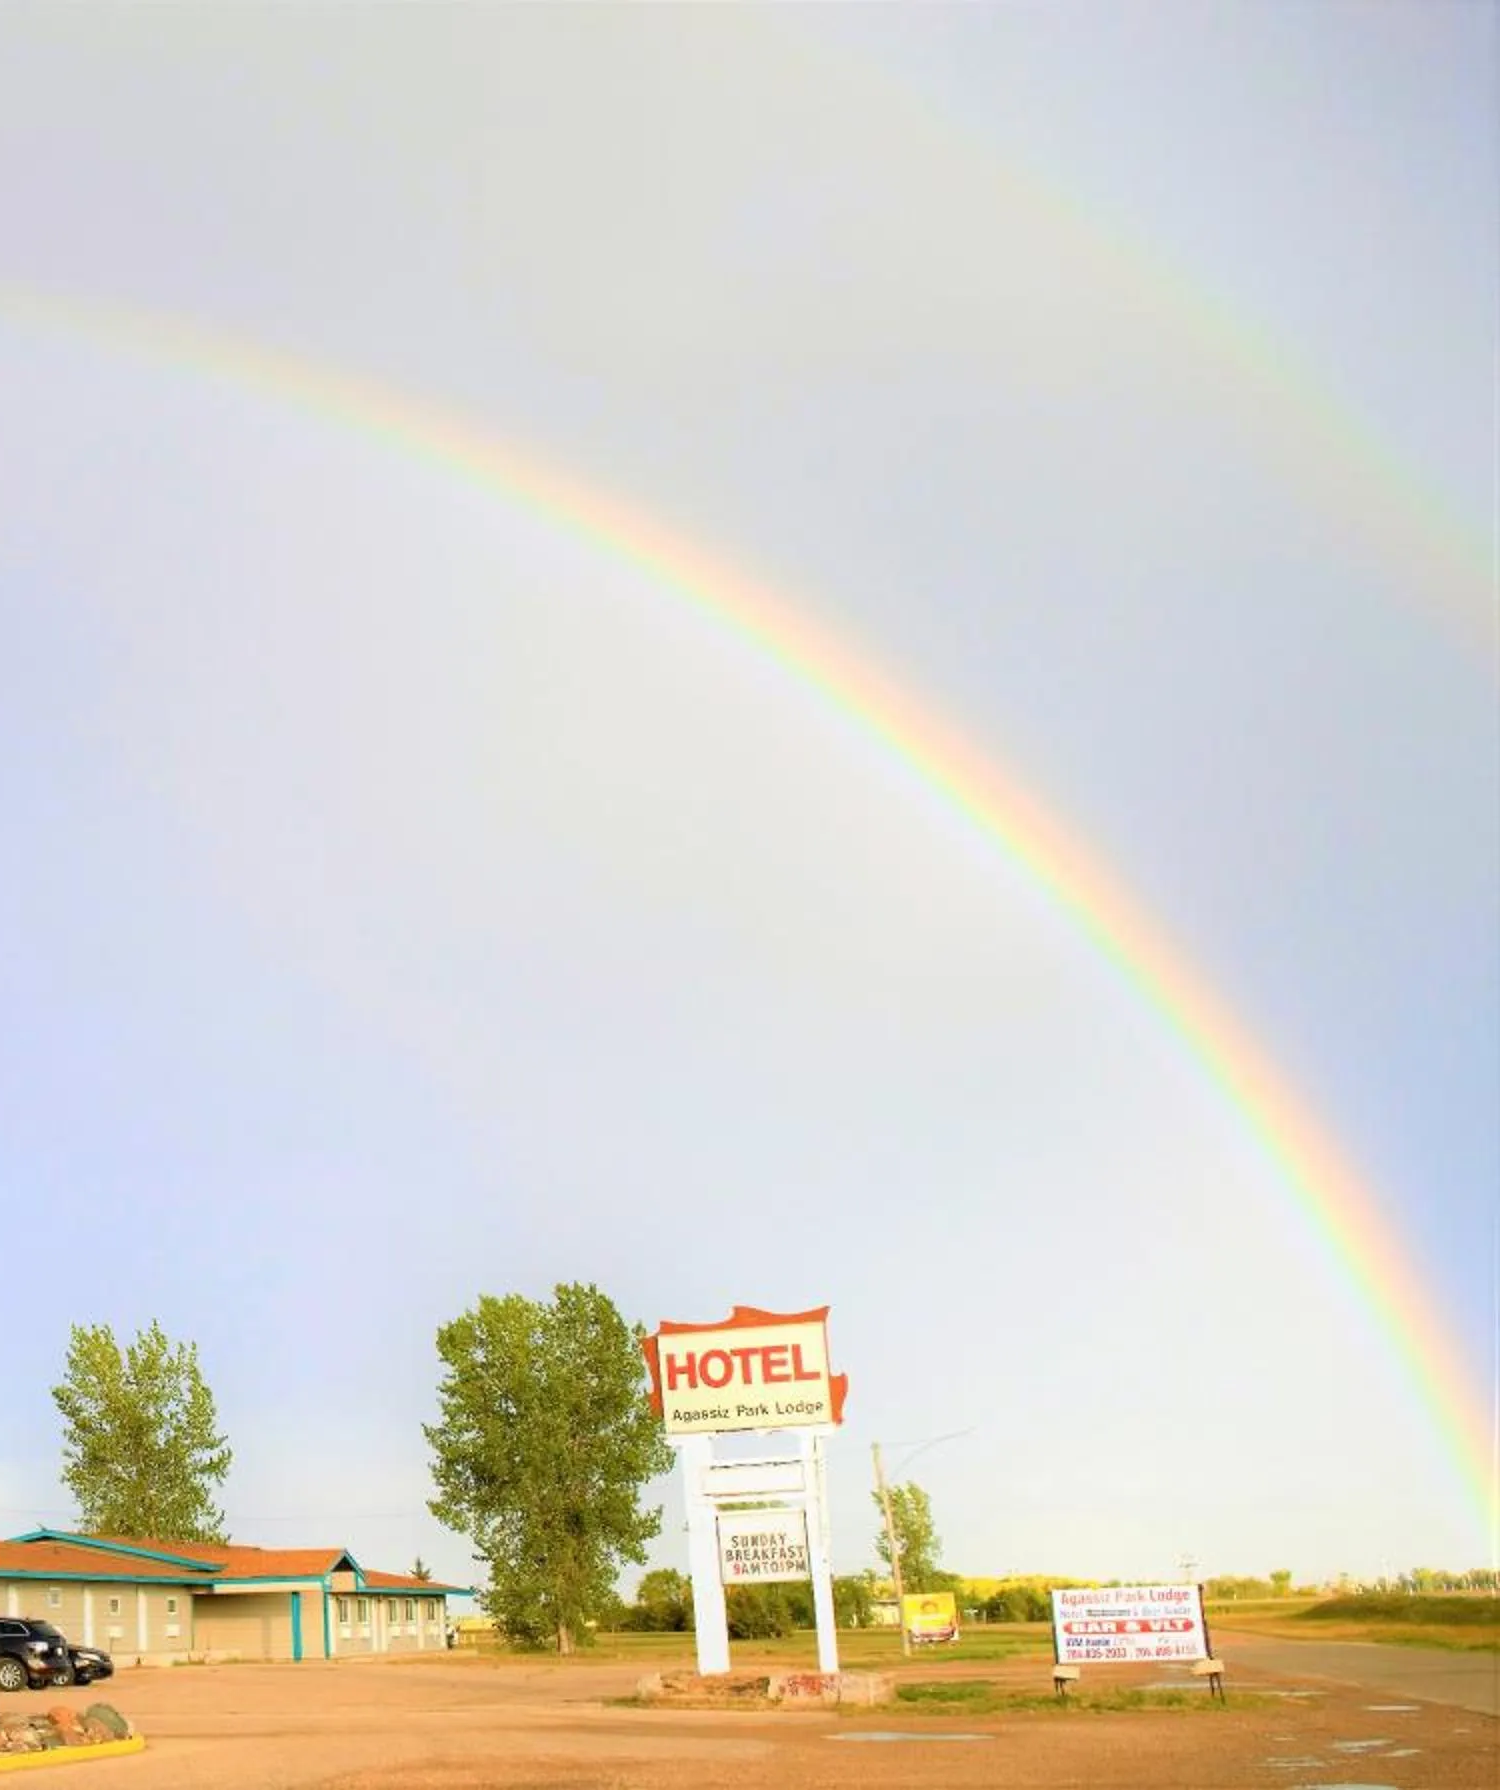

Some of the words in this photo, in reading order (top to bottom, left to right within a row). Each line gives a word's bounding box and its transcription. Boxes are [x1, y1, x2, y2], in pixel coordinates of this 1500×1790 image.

[666, 1344, 821, 1390] HOTEL
[673, 1404, 730, 1423] Agassiz
[736, 1402, 769, 1417] Park
[775, 1400, 824, 1415] Lodge
[731, 1532, 787, 1548] SUNDAY
[726, 1545, 804, 1562] BREAKFAST
[1149, 1588, 1190, 1605] Lodge
[1071, 1621, 1116, 1633] BAR
[1125, 1620, 1141, 1632] &
[1148, 1618, 1185, 1632] VLT
